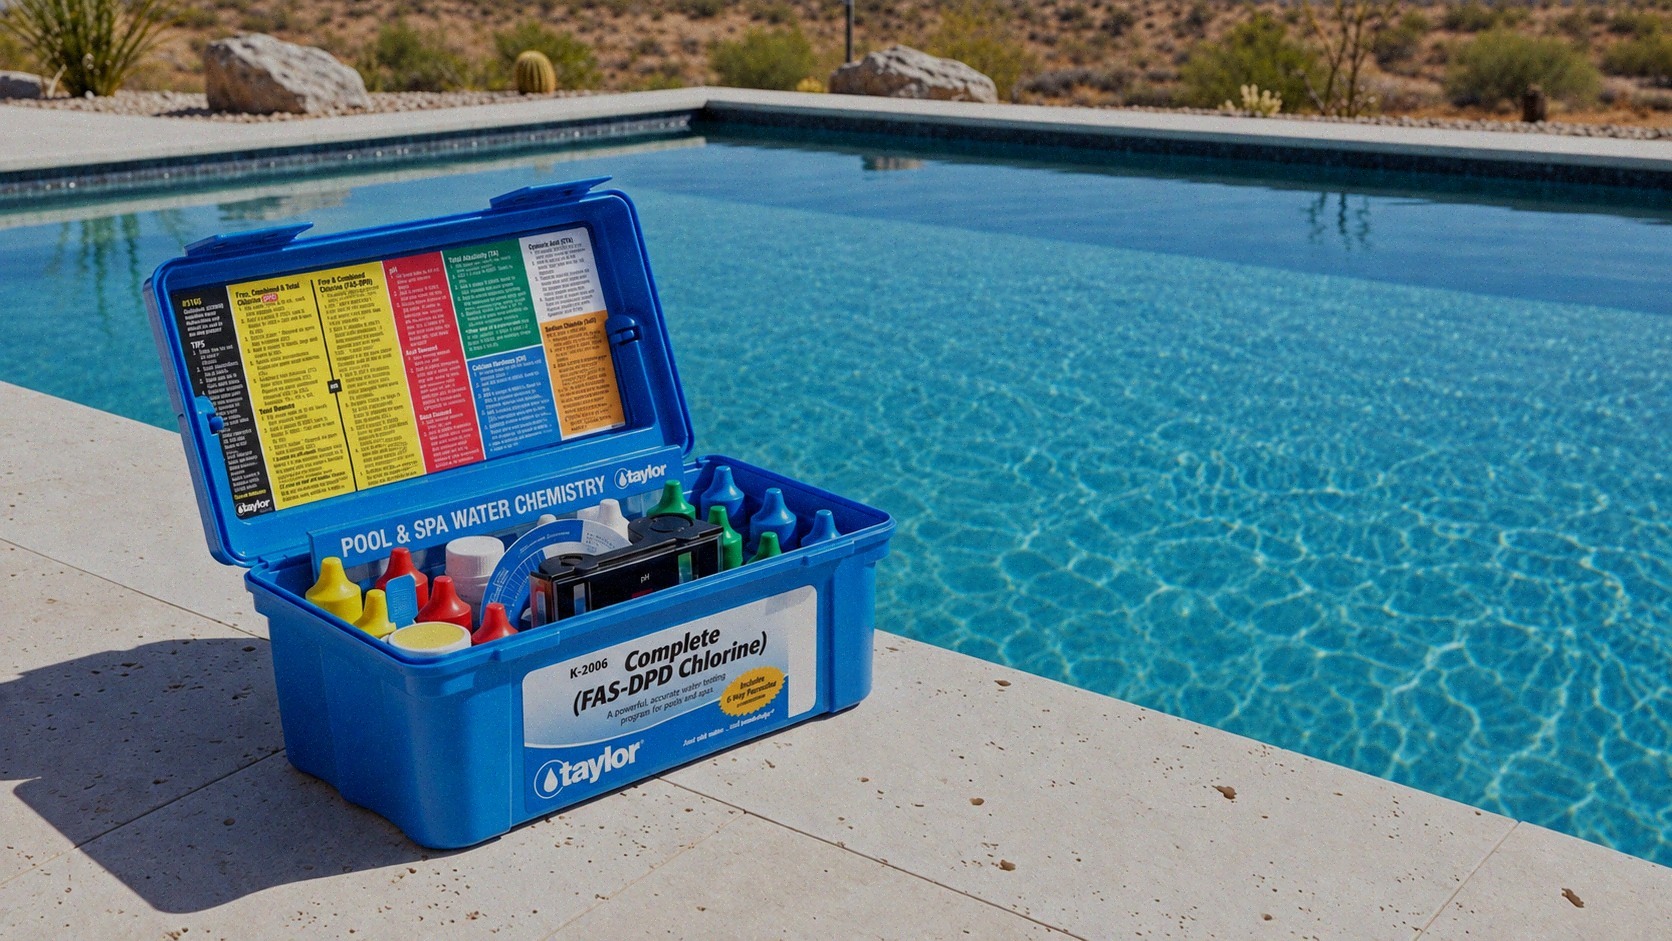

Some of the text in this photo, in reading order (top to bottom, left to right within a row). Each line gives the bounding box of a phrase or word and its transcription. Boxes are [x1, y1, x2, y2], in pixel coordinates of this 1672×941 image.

[448, 255, 462, 264] Total
[625, 463, 667, 485] taylor
[242, 499, 270, 512] taylor
[341, 476, 605, 558] POOL & SPA WATER CHEMISTRY
[640, 572, 650, 584] pH
[624, 628, 721, 672] Complete
[570, 657, 608, 680] K-2006
[573, 631, 767, 717] (FAS-DPD Chlorine)
[606, 710, 614, 720] A
[650, 688, 680, 704] accurate
[681, 682, 702, 694] water
[620, 709, 650, 727] program
[652, 703, 662, 713] for
[684, 692, 697, 702] and
